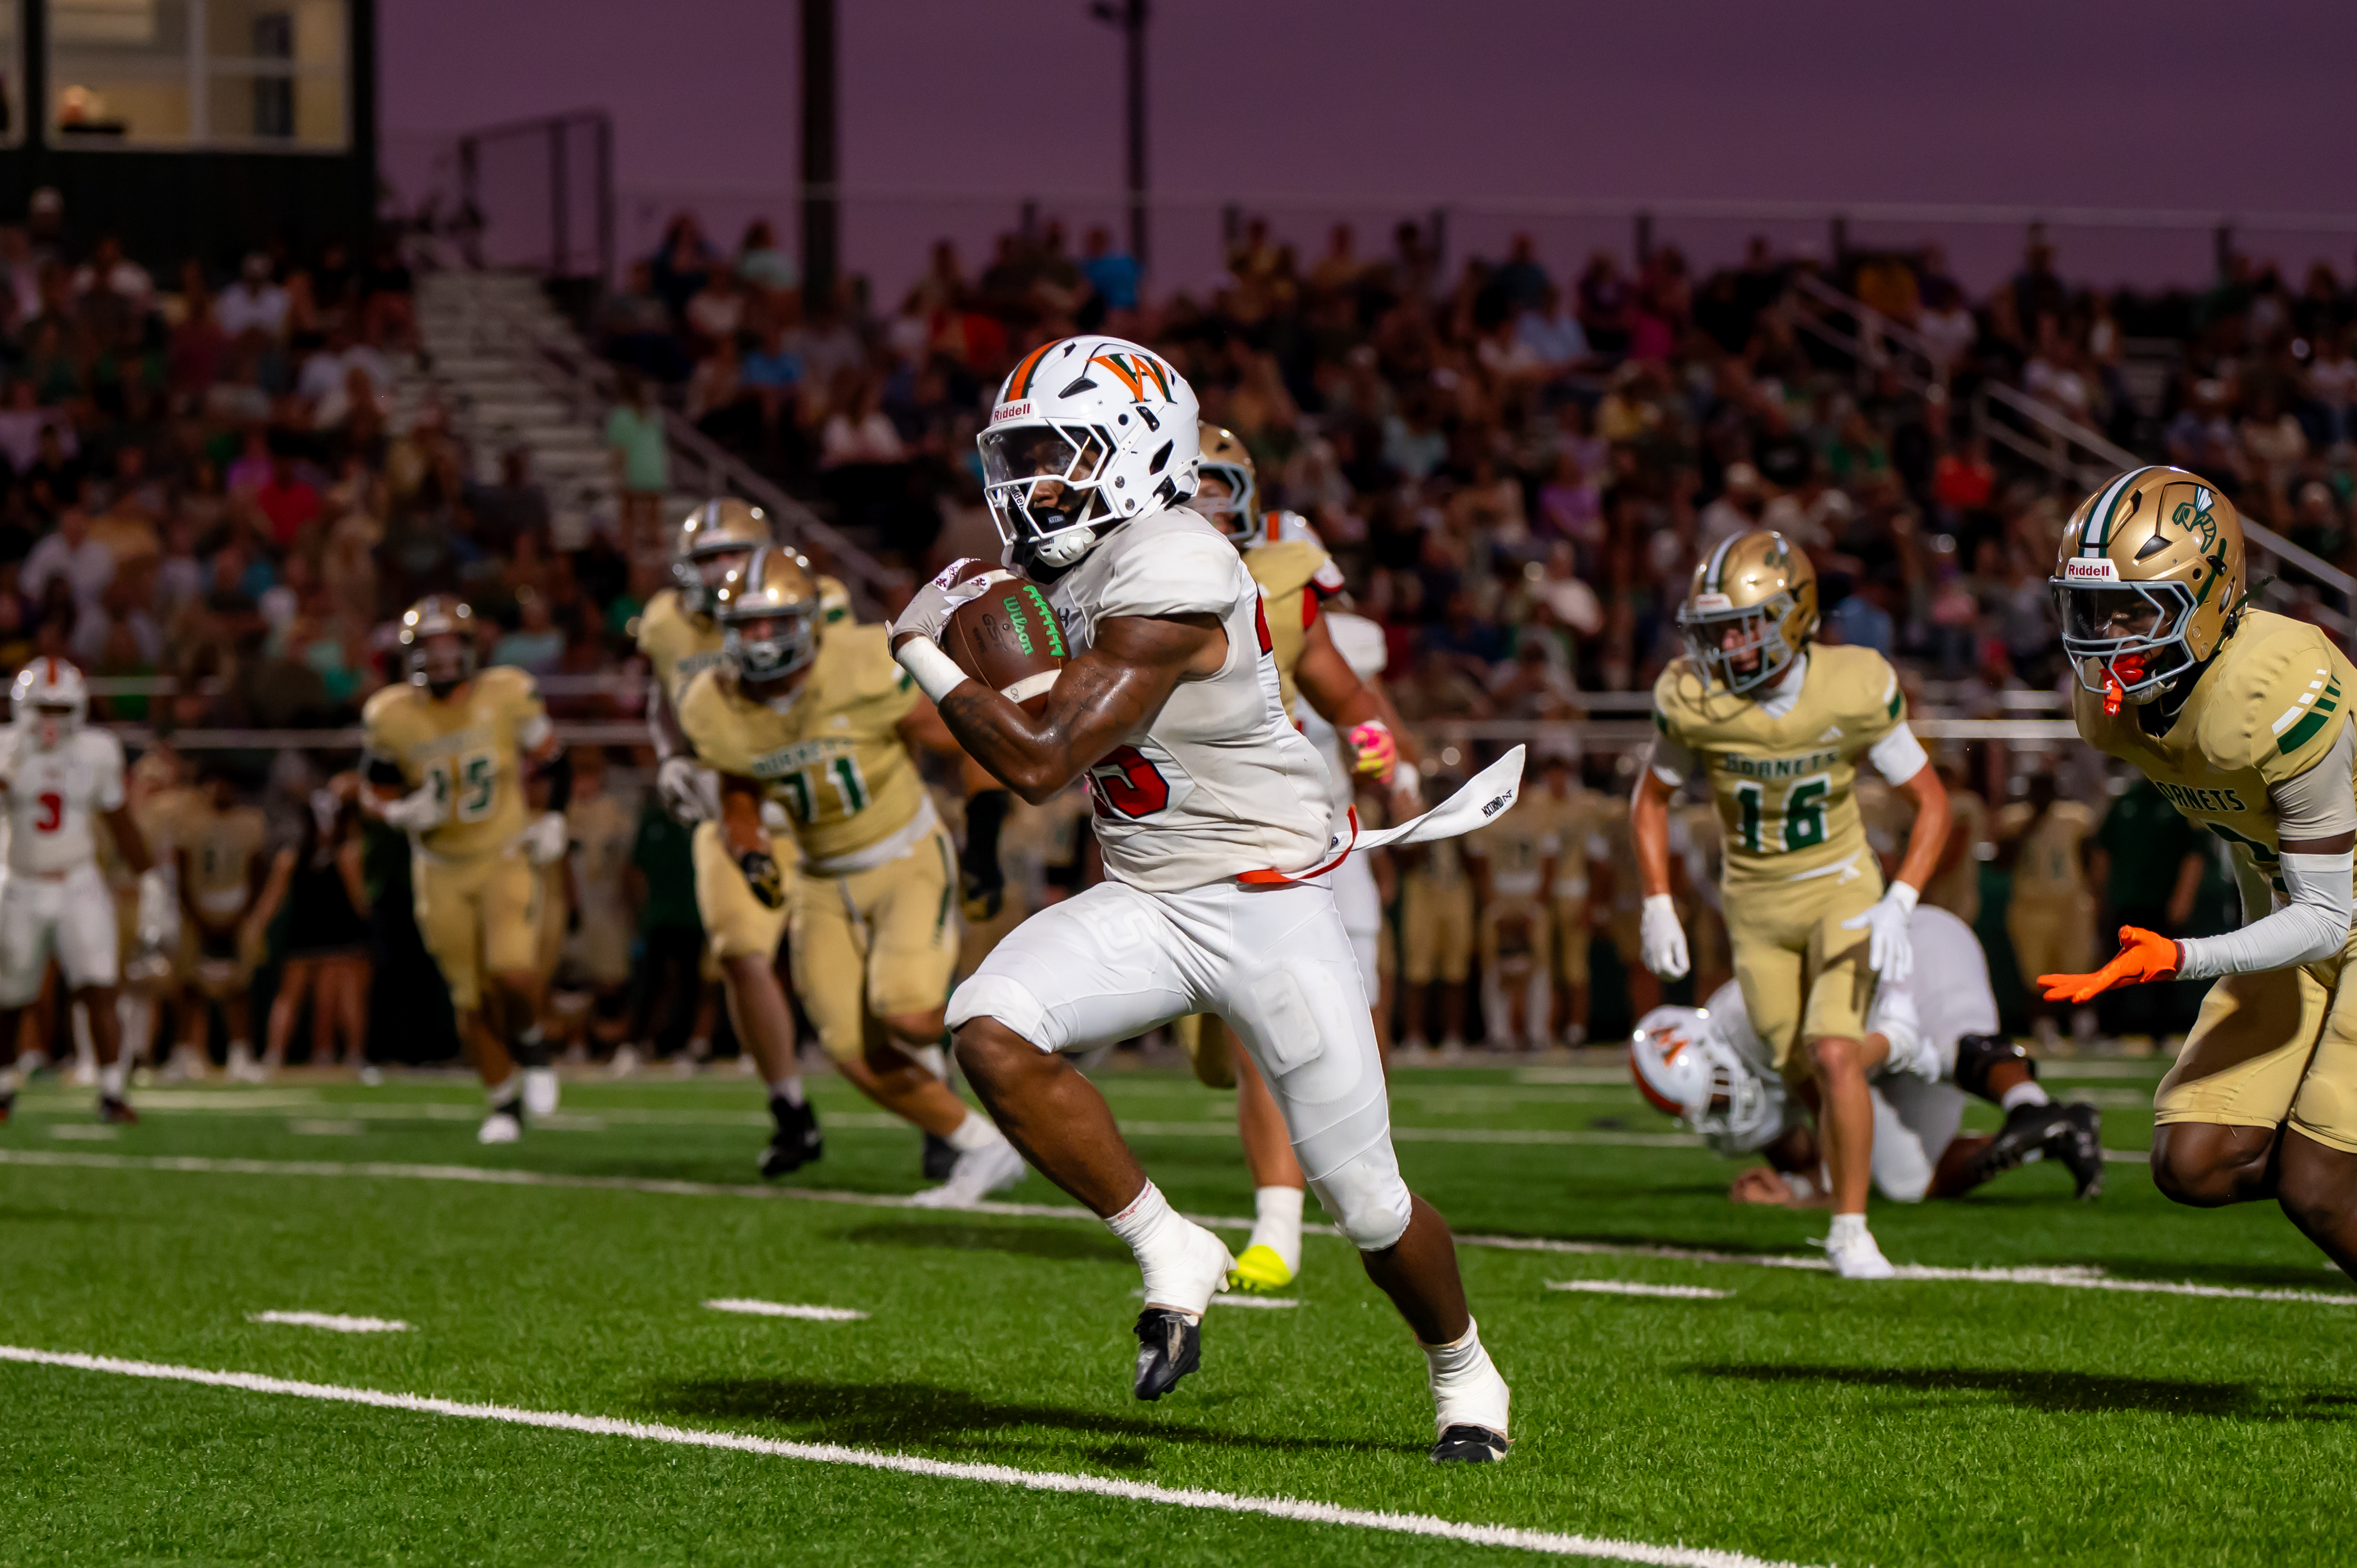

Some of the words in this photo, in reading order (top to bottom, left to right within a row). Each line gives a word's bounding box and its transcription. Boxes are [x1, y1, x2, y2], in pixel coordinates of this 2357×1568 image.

[994, 404, 1030, 421] Riddell
[2069, 564, 2110, 576] Riddell
[1002, 595, 1034, 656] Wilson
[37, 791, 61, 832] 3
[1734, 774, 1830, 853] 16
[2154, 780, 2247, 812] ORNETS
